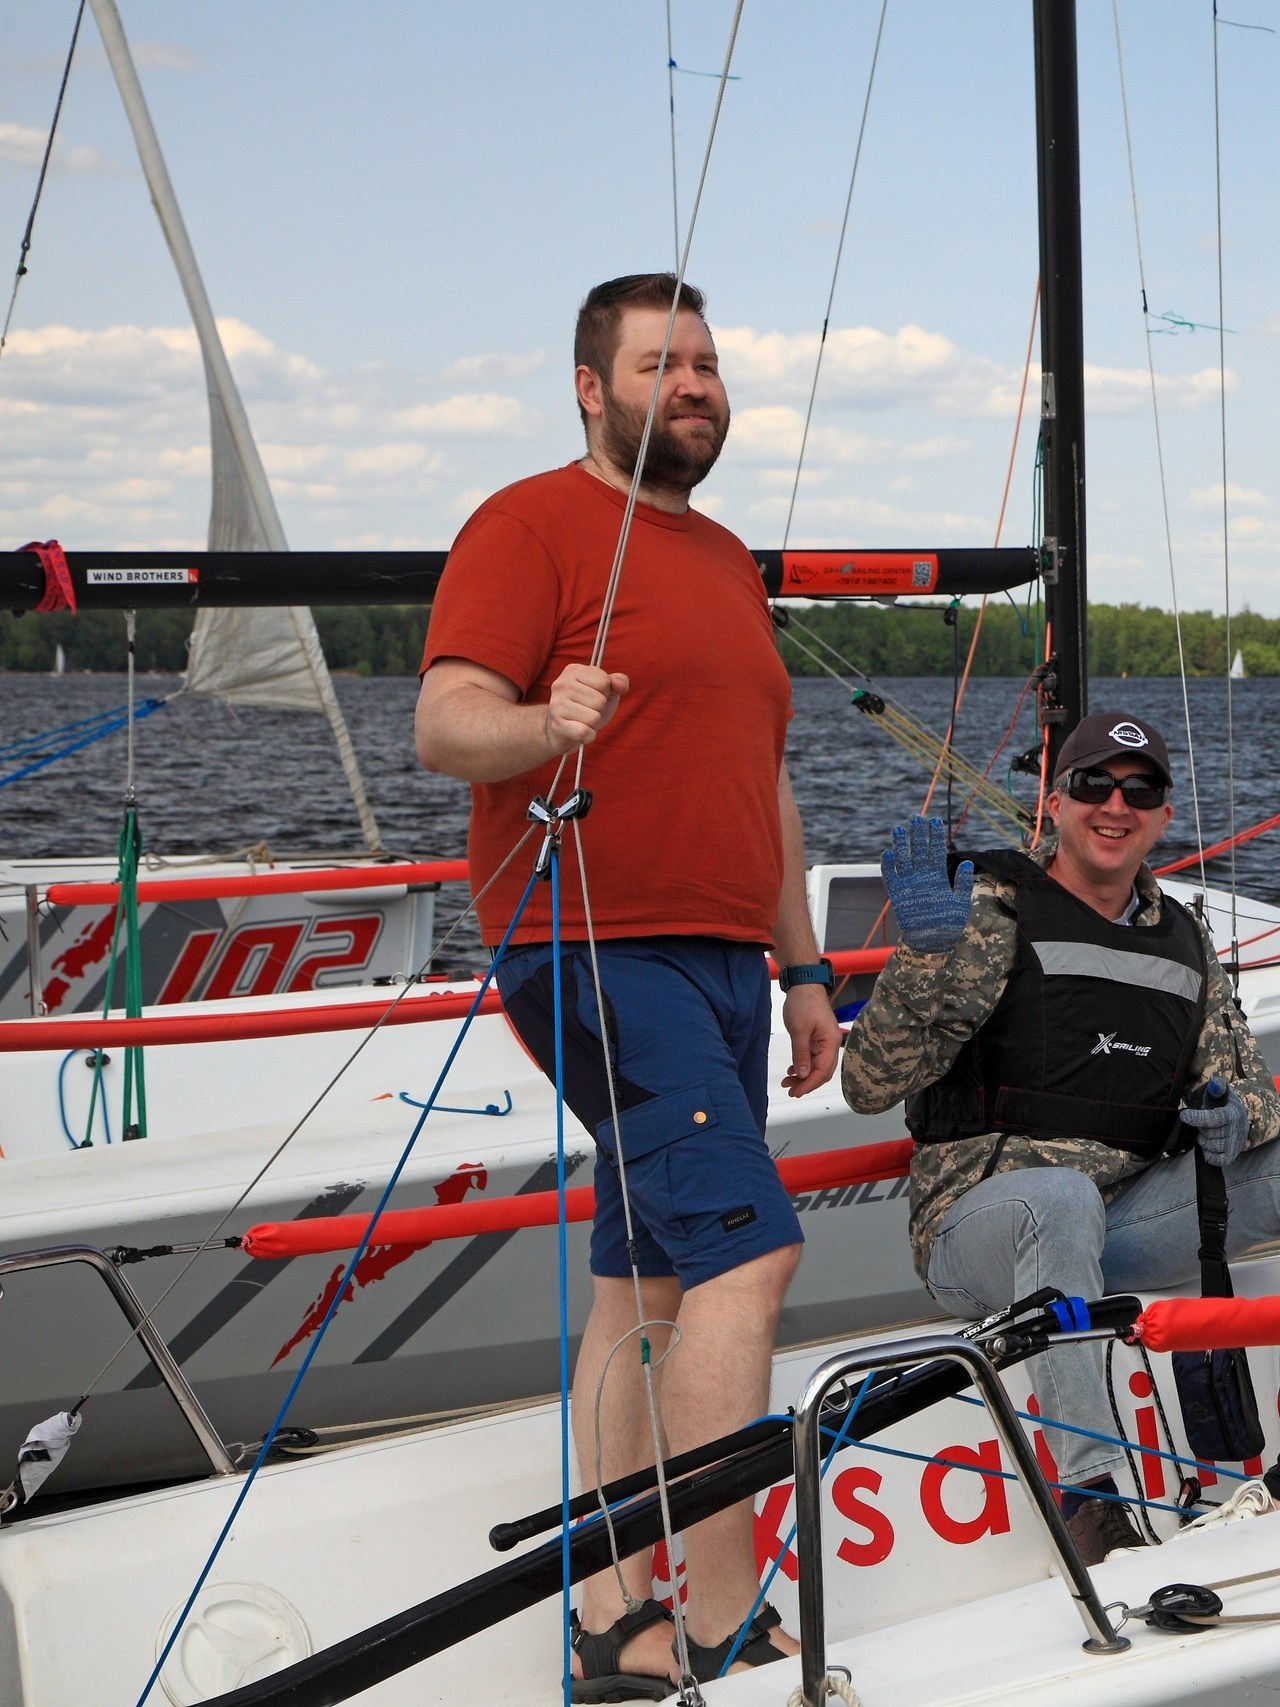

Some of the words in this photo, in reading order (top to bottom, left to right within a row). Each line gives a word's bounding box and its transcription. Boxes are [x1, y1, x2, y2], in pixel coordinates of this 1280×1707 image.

[93, 572, 123, 581] WIND
[126, 571, 184, 581] BROTHERS
[1113, 730, 1146, 741] NISSAN
[156, 912, 384, 1005] 102
